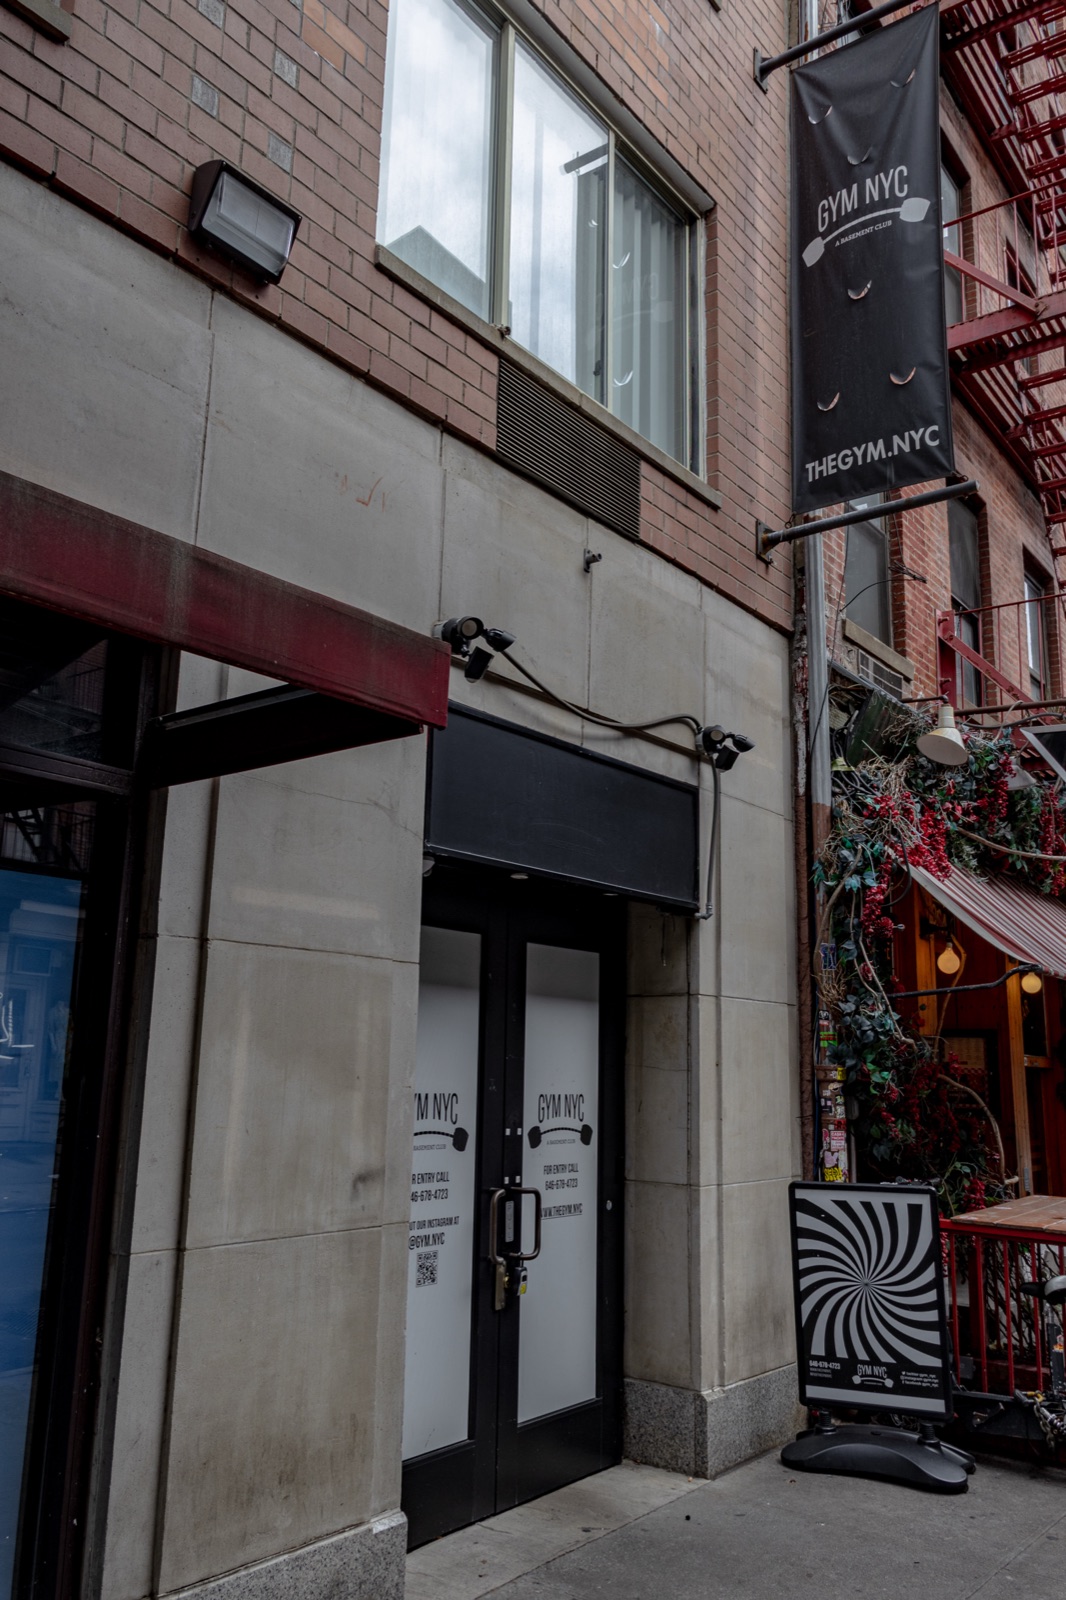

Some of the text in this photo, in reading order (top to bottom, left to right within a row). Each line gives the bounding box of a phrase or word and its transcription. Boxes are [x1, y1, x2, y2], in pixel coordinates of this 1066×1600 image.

[818, 165, 908, 233] GYM NYC
[840, 226, 874, 245] BASEMENT
[874, 219, 893, 231] CLUB
[805, 425, 940, 483] THEGYM.NYC
[433, 1092, 459, 1125] NYC
[538, 1093, 585, 1123] GYM NYC
[417, 1172, 435, 1184] ENTRY
[436, 1171, 450, 1183] CALL
[543, 1162, 579, 1175] FOR ENTRY CALL
[427, 1216, 453, 1228] INSTAGRAM
[453, 1215, 460, 1225] AT
[408, 1232, 445, 1250] @GYM.NYC
[857, 1363, 888, 1379] GYM NYC
